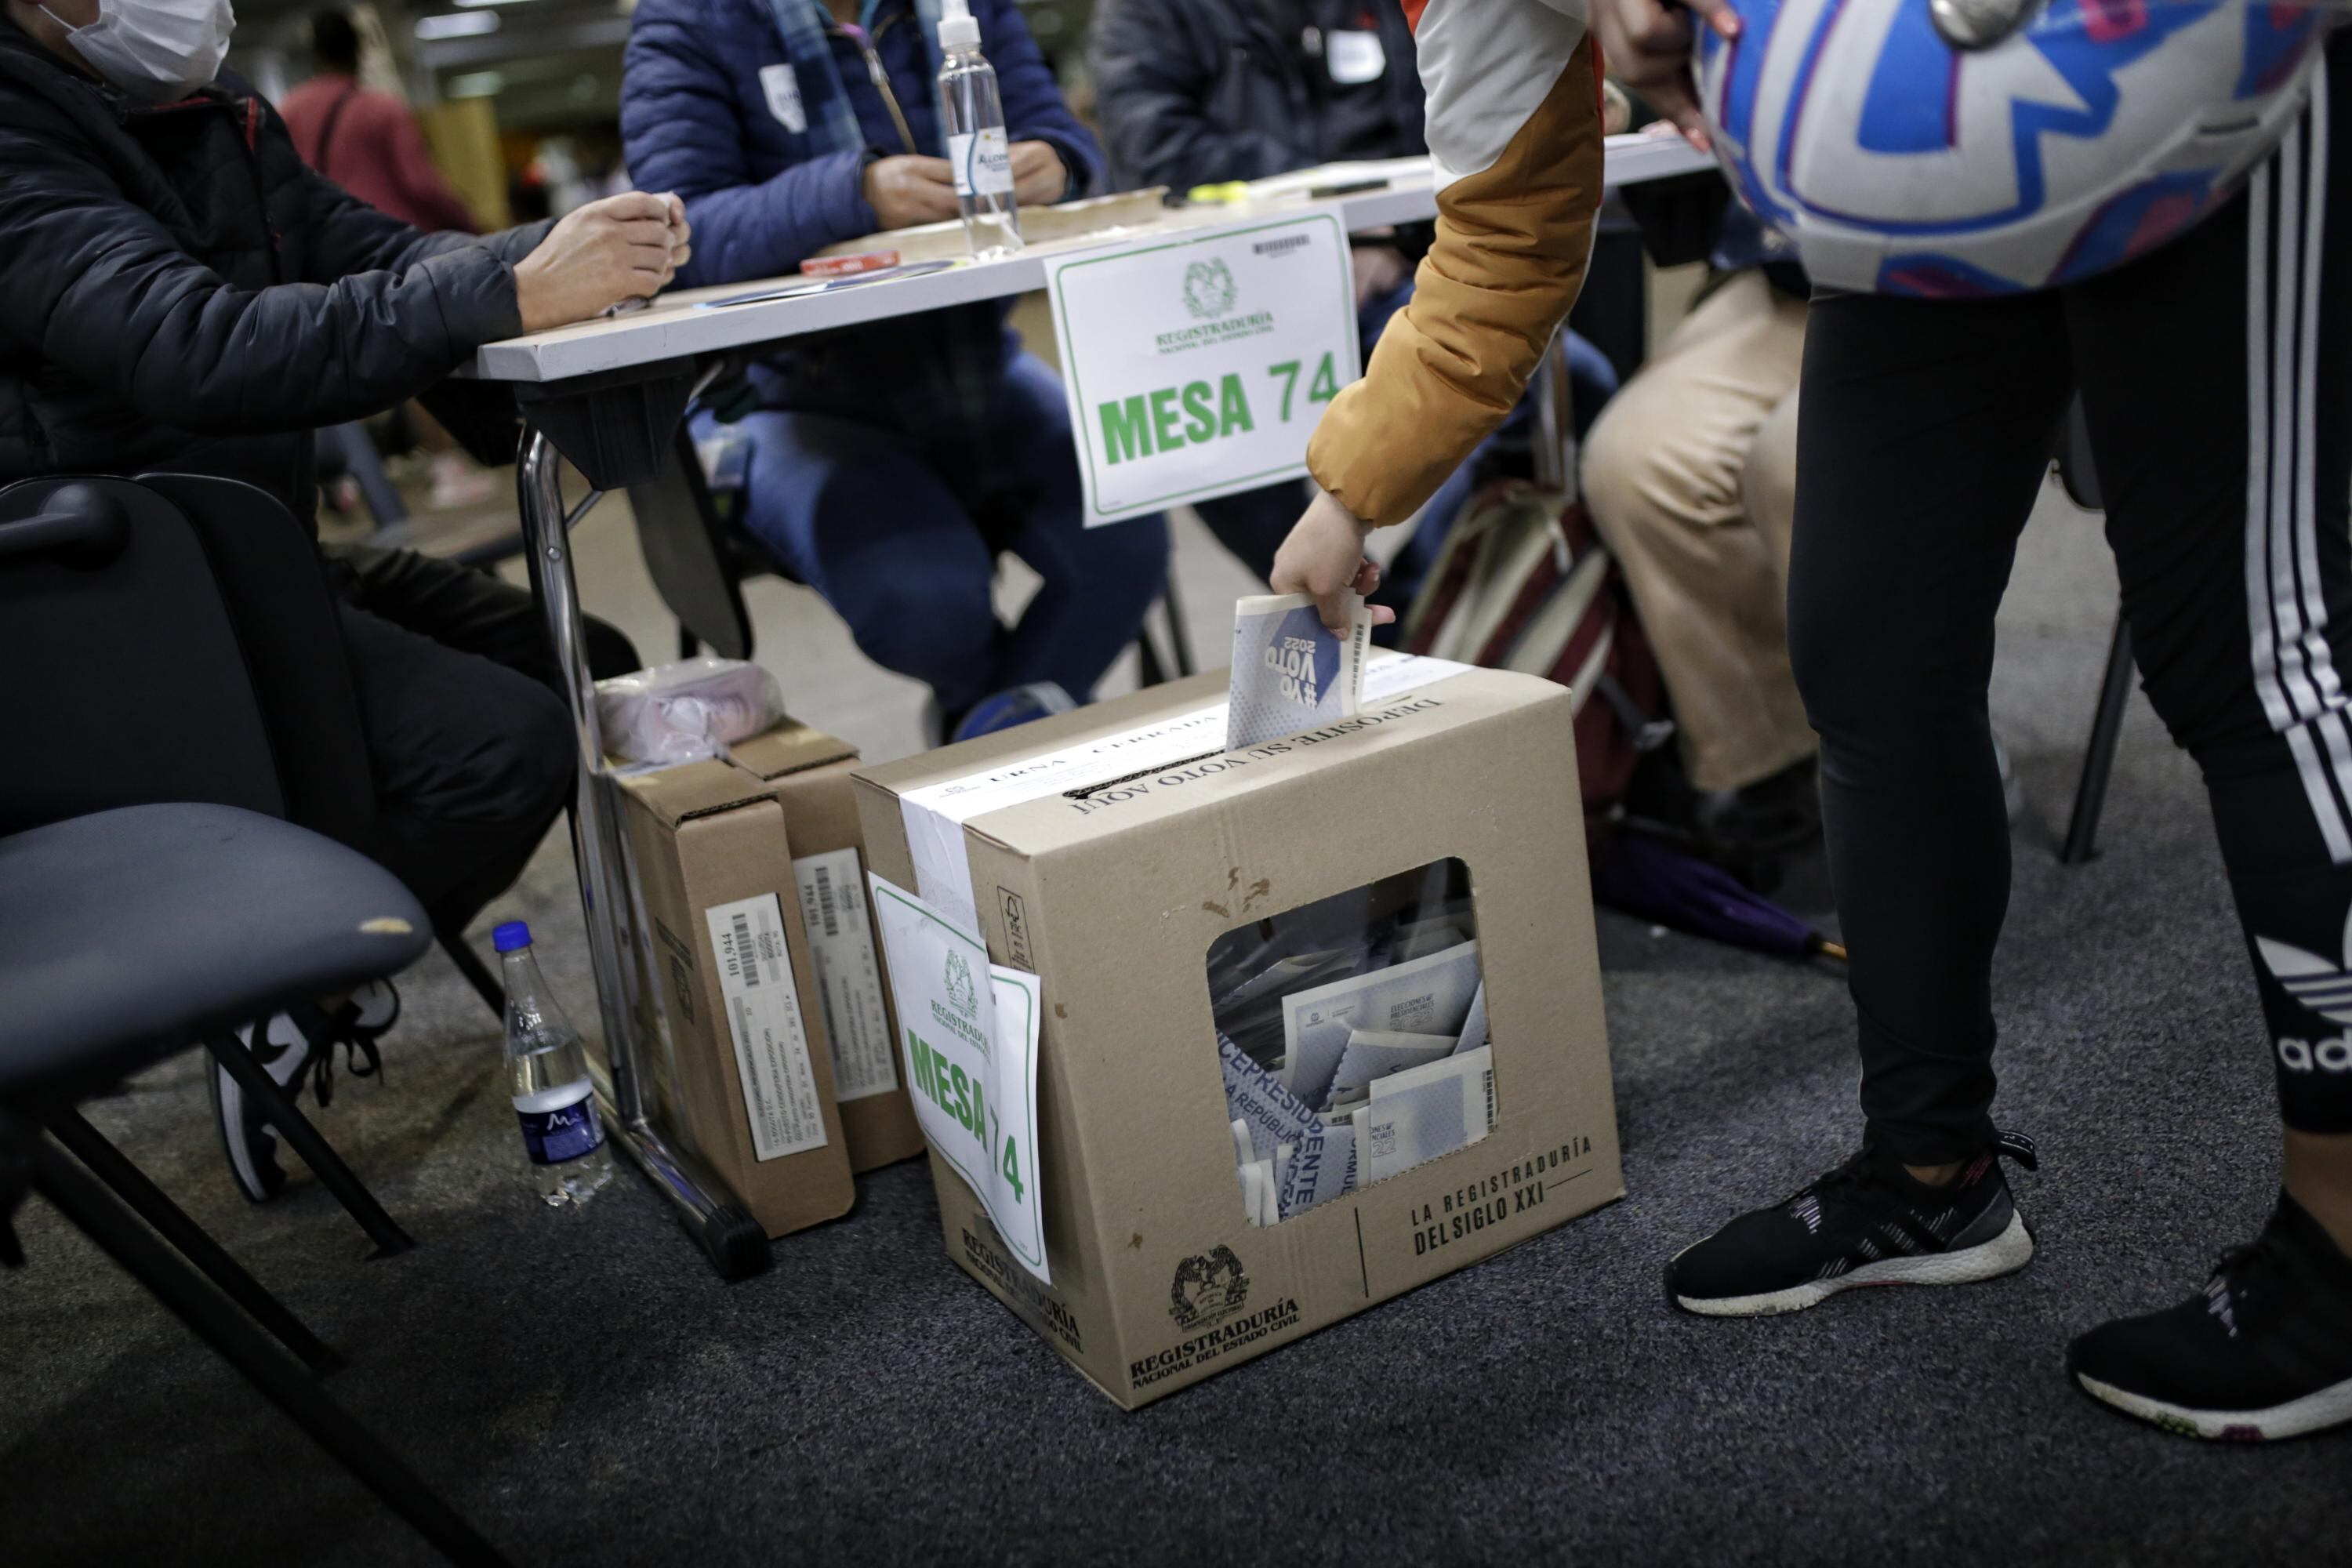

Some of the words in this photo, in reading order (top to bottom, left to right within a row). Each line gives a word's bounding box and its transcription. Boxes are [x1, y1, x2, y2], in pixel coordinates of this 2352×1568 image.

[1098, 372, 1255, 465] MESA
[1268, 350, 1340, 423] 74
[1265, 646, 1317, 685] VOTO
[1284, 637, 1316, 654] 2022
[1279, 674, 1318, 710] #YO
[1291, 699, 1445, 746] DEPOSITE
[989, 760, 1067, 782] URNA
[1091, 717, 1218, 754] CERRADA
[1158, 757, 1247, 786] VOTO
[1248, 742, 1293, 760] SU
[1068, 783, 1150, 815] AQUÍ
[720, 931, 740, 978] 101.944
[907, 1028, 988, 1155] MESA
[990, 1103, 1024, 1204] 74
[1412, 1203, 1432, 1226] LA
[1443, 1136, 1592, 1213] REGISTRADURÍA
[1414, 1222, 1449, 1256] DEL
[1453, 1197, 1507, 1239] SIGLO
[1515, 1181, 1544, 1213] XXI
[1130, 1298, 1299, 1379] REGISTRADURÍA
[1132, 1359, 1193, 1390] NACIONAL
[1196, 1347, 1221, 1364] DEL
[1223, 1327, 1269, 1354] ESTADO
[1270, 1314, 1300, 1333] CIVIL
